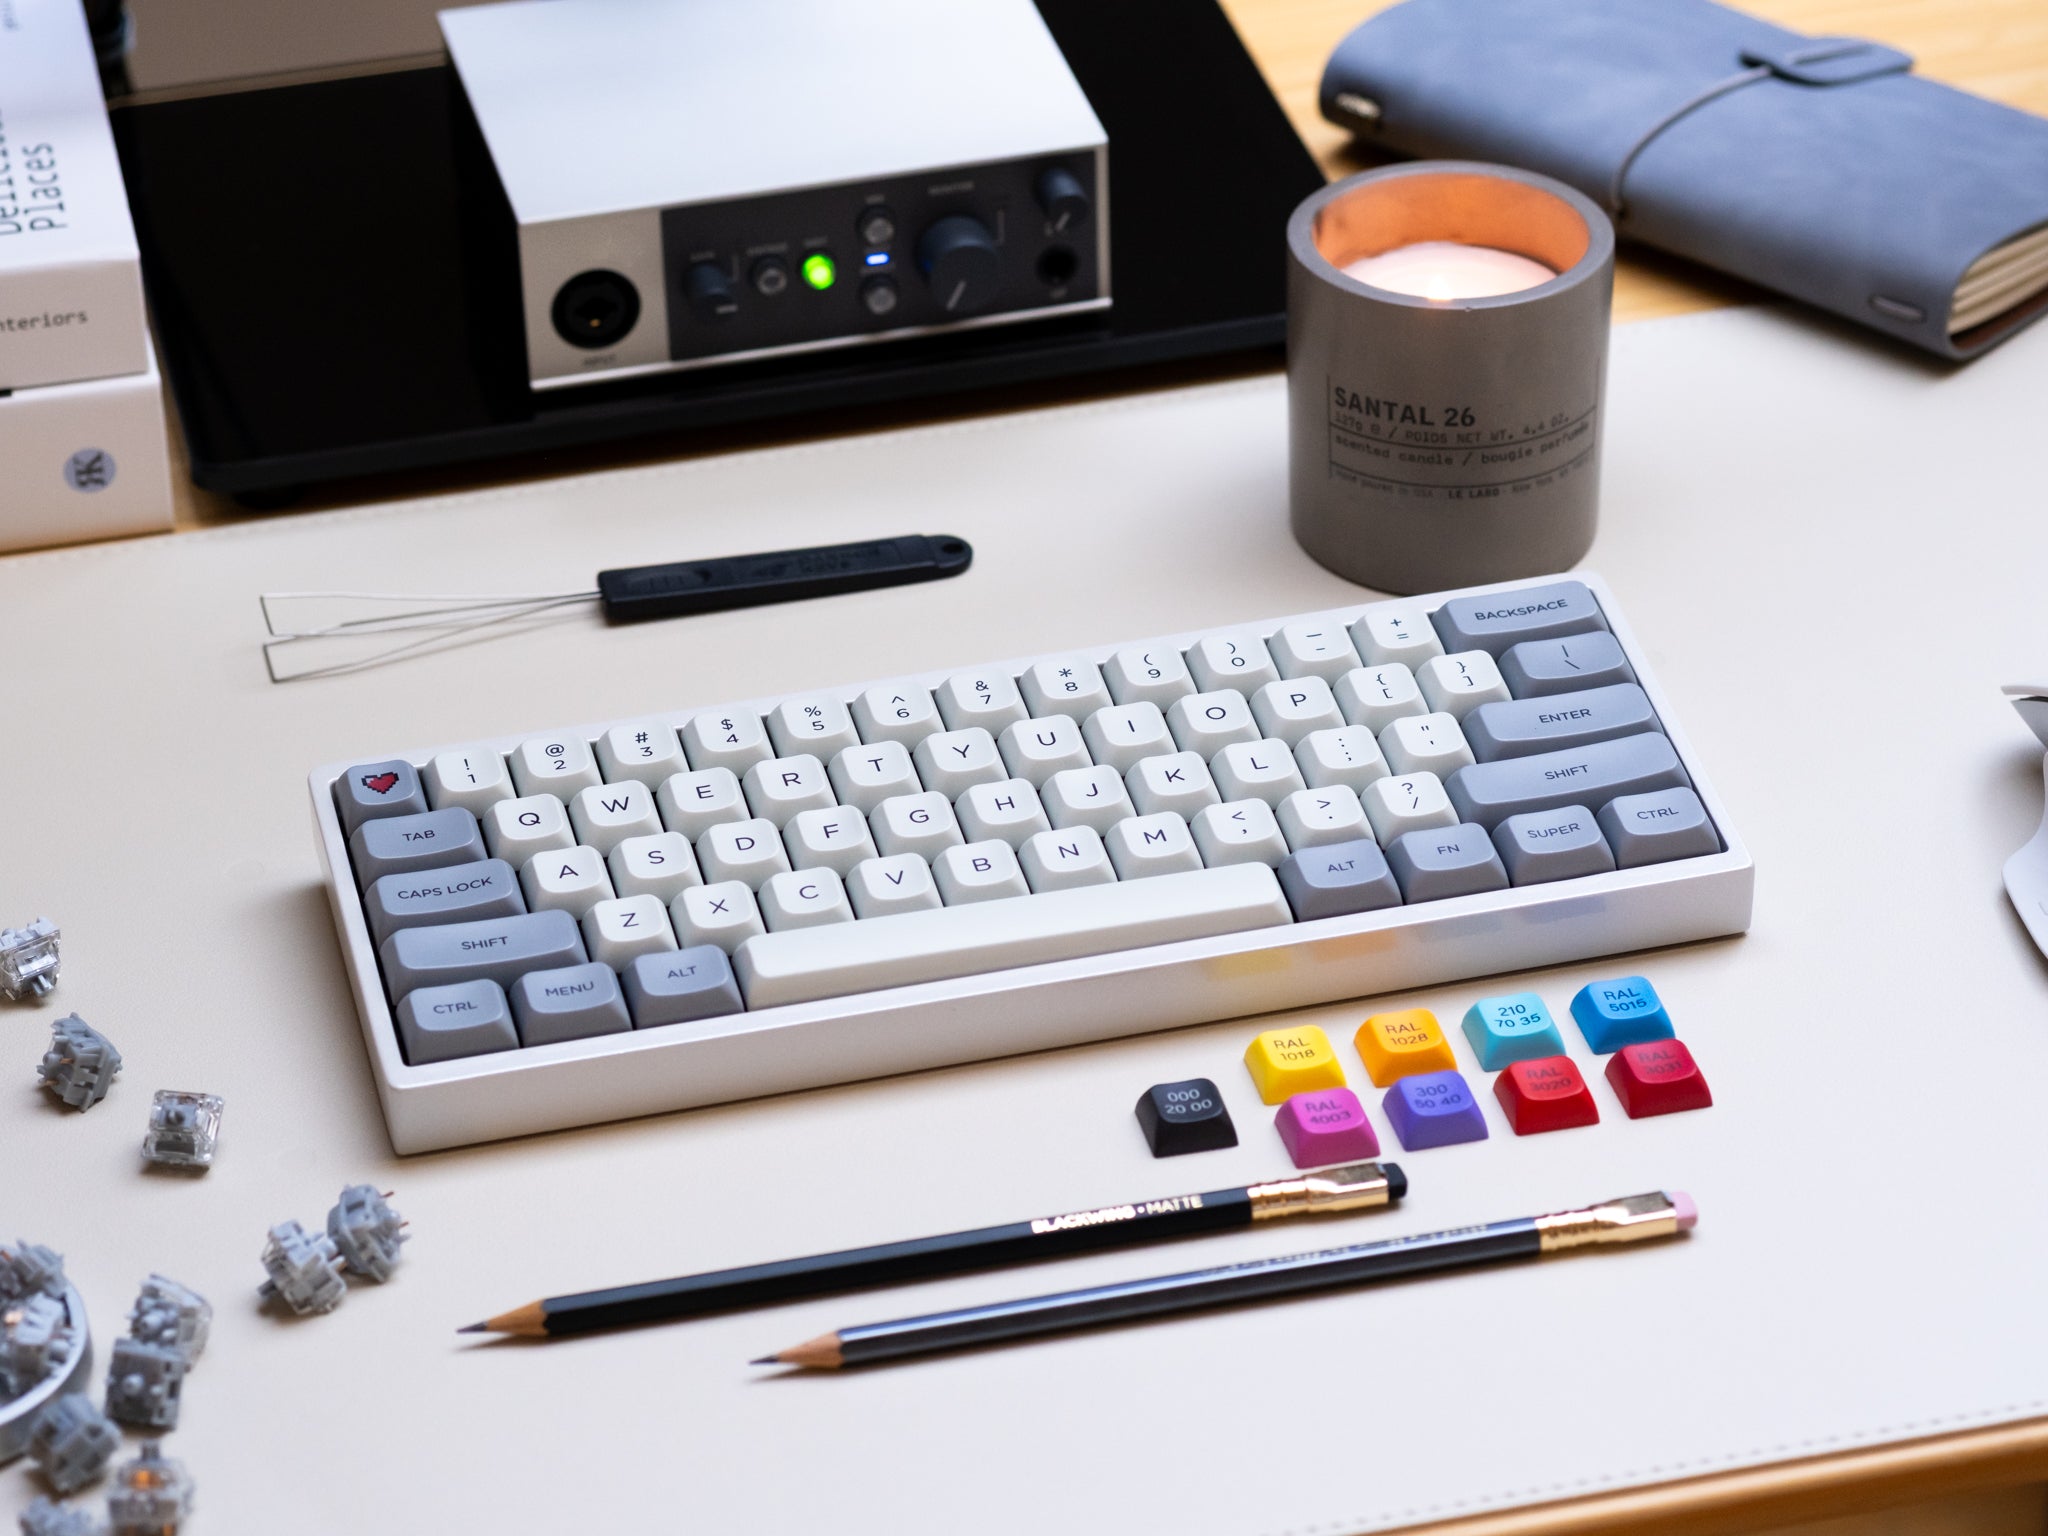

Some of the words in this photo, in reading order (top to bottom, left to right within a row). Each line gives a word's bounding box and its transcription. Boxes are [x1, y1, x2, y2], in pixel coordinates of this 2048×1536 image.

[22, 143, 67, 231] Places
[1335, 386, 1435, 426] SANTAL
[1444, 407, 1475, 427] 26
[1405, 430, 1448, 443] POIDS
[1457, 431, 1481, 443] NET
[1336, 435, 1390, 459] scented
[1399, 453, 1453, 465] candle
[1481, 447, 1533, 464] bougie
[1474, 599, 1569, 621] BACKSPACE
[1228, 643, 1235, 653] )
[1144, 654, 1152, 665] (
[1148, 669, 1160, 678] 9
[1457, 662, 1465, 673] }
[1377, 674, 1385, 685] {
[1465, 676, 1473, 686] ]
[976, 681, 989, 691] &
[1065, 682, 1077, 691] 8
[981, 695, 990, 704] 7
[1383, 689, 1392, 698] [
[1291, 694, 1306, 706] P
[805, 706, 821, 717] %
[897, 709, 909, 718] 6
[1206, 707, 1226, 719] O
[1539, 709, 1591, 723] ENTER
[721, 719, 733, 730] $
[813, 721, 824, 730] 5
[1128, 720, 1134, 732] I
[636, 732, 648, 743] #
[727, 734, 738, 742] 4
[1037, 732, 1056, 745] U
[545, 744, 564, 757] @
[640, 747, 652, 756] 3
[953, 745, 969, 758] Y
[464, 759, 469, 770] !
[554, 760, 566, 770] 2
[868, 758, 882, 771] T
[1251, 758, 1268, 769] L
[1165, 769, 1184, 782] K
[1545, 765, 1587, 779] SHIFT
[468, 774, 475, 783] 1
[782, 773, 801, 786] R
[696, 785, 713, 798] E
[1087, 783, 1098, 796] J
[1402, 783, 1413, 794] ?
[602, 797, 629, 812] W
[995, 796, 1014, 810] H
[1318, 800, 1330, 808] >
[1413, 797, 1418, 808] /
[519, 813, 540, 826] Q
[910, 810, 929, 823] G
[1232, 812, 1245, 820] <
[1637, 808, 1679, 819] CTRL
[403, 830, 435, 841] TAB
[824, 824, 838, 838] F
[1528, 823, 1580, 838] SUPER
[1144, 830, 1166, 844] M
[736, 838, 754, 850] D
[1438, 845, 1460, 854] FN
[1059, 844, 1079, 858] N
[648, 851, 664, 864] S
[973, 858, 991, 871] B
[1329, 861, 1354, 872] ALT
[560, 865, 578, 878] A
[886, 871, 903, 884] V
[398, 888, 442, 899] CAPS
[447, 877, 492, 893] LOCK
[800, 886, 818, 899] C
[709, 899, 728, 913] X
[621, 913, 638, 927] Z
[462, 937, 507, 949] SHIFT
[668, 966, 696, 978] ALT
[546, 981, 594, 996] MENU
[1603, 988, 1641, 1000] RAL
[434, 1002, 477, 1013] CTRL
[1498, 1004, 1526, 1016] 210
[1609, 998, 1647, 1011] 5015
[1495, 1019, 1516, 1028] 70
[1520, 1013, 1541, 1026] 35
[1385, 1022, 1422, 1034] RAL
[1273, 1037, 1311, 1049] RAL
[1391, 1033, 1429, 1046] 1028
[1280, 1049, 1316, 1061] 1018
[1638, 1050, 1676, 1062] RAL
[1527, 1066, 1564, 1080] RAL
[1167, 1088, 1200, 1102] 000
[1415, 1084, 1448, 1097] 300
[1441, 1094, 1462, 1105] 40
[1164, 1104, 1187, 1114] 20
[1190, 1098, 1213, 1112] 00
[1305, 1100, 1342, 1113] RAL
[1146, 1195, 1203, 1215] MATTE
